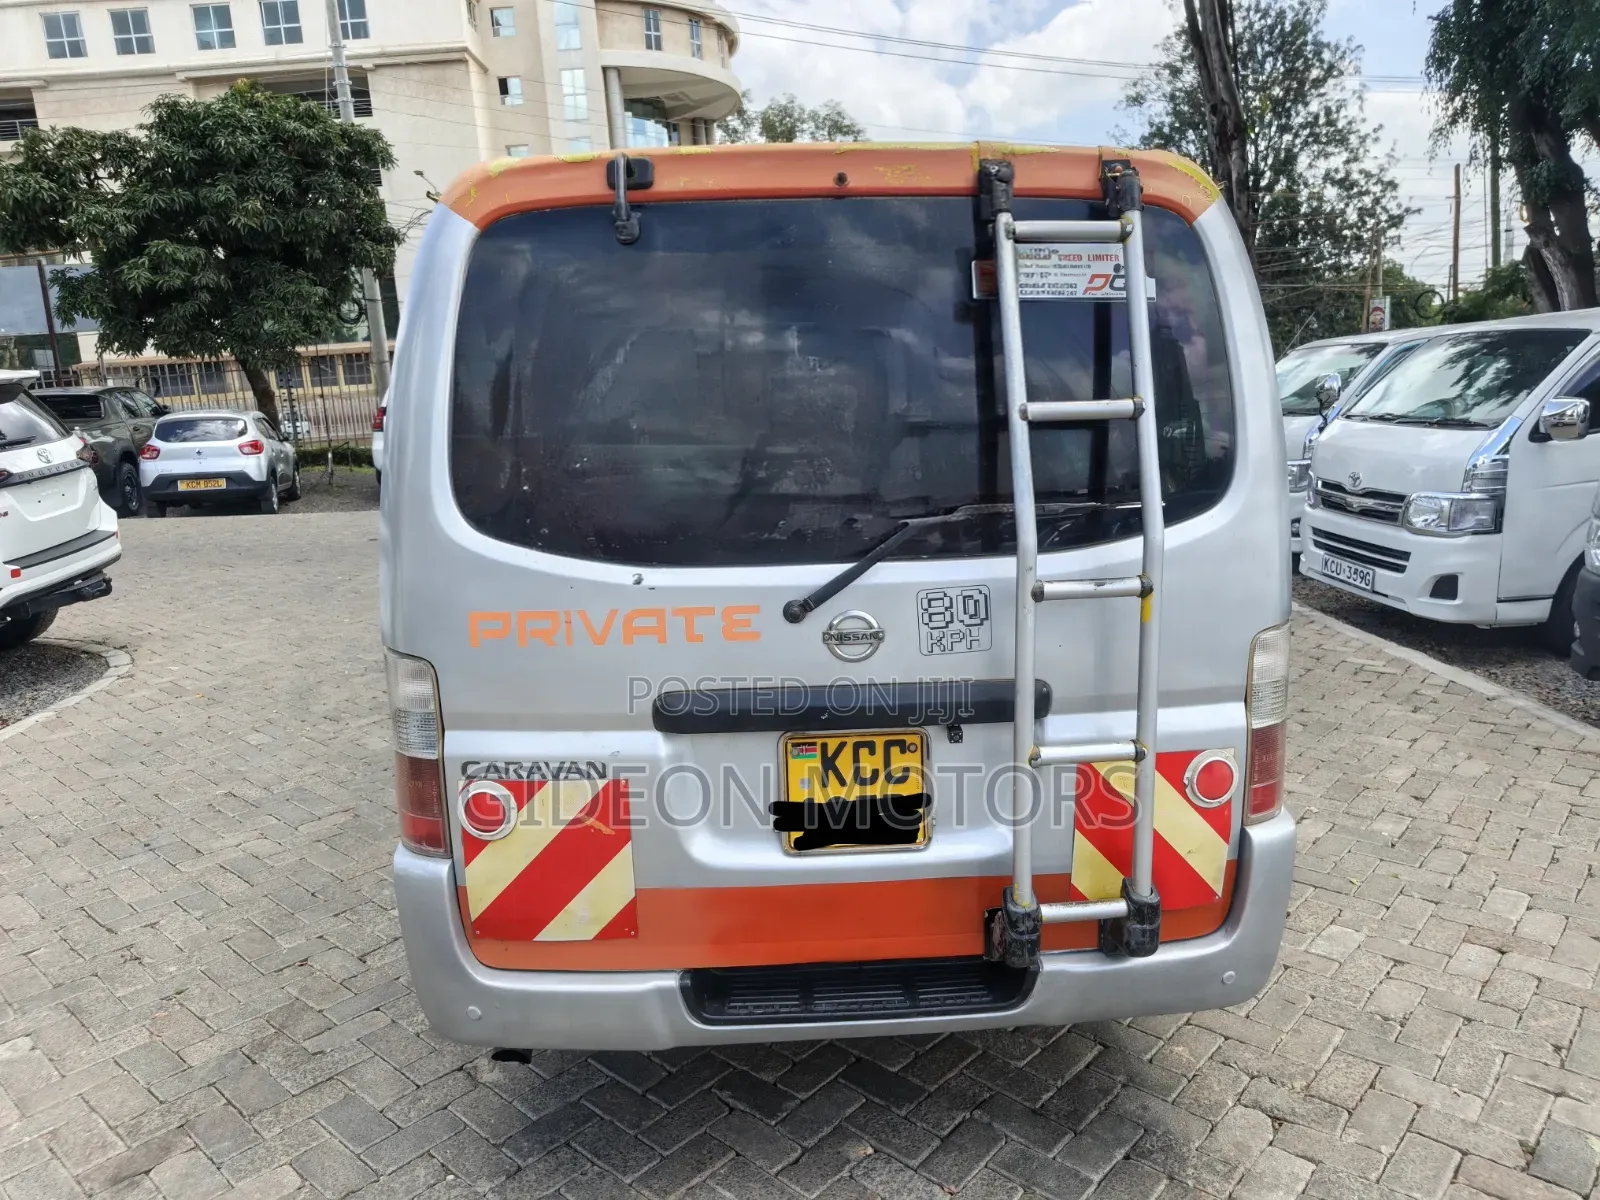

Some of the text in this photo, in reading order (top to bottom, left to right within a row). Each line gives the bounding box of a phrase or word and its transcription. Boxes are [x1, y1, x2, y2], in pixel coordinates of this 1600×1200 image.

[1088, 254, 1119, 262] LIMITER
[186, 481, 201, 489] KCM
[1323, 556, 1371, 587] KCU 359G
[920, 588, 989, 630] 80
[829, 631, 879, 644] NISSAN
[926, 627, 982, 653] KPH
[460, 760, 607, 780] CARAVAN
[820, 738, 911, 788] KCC
